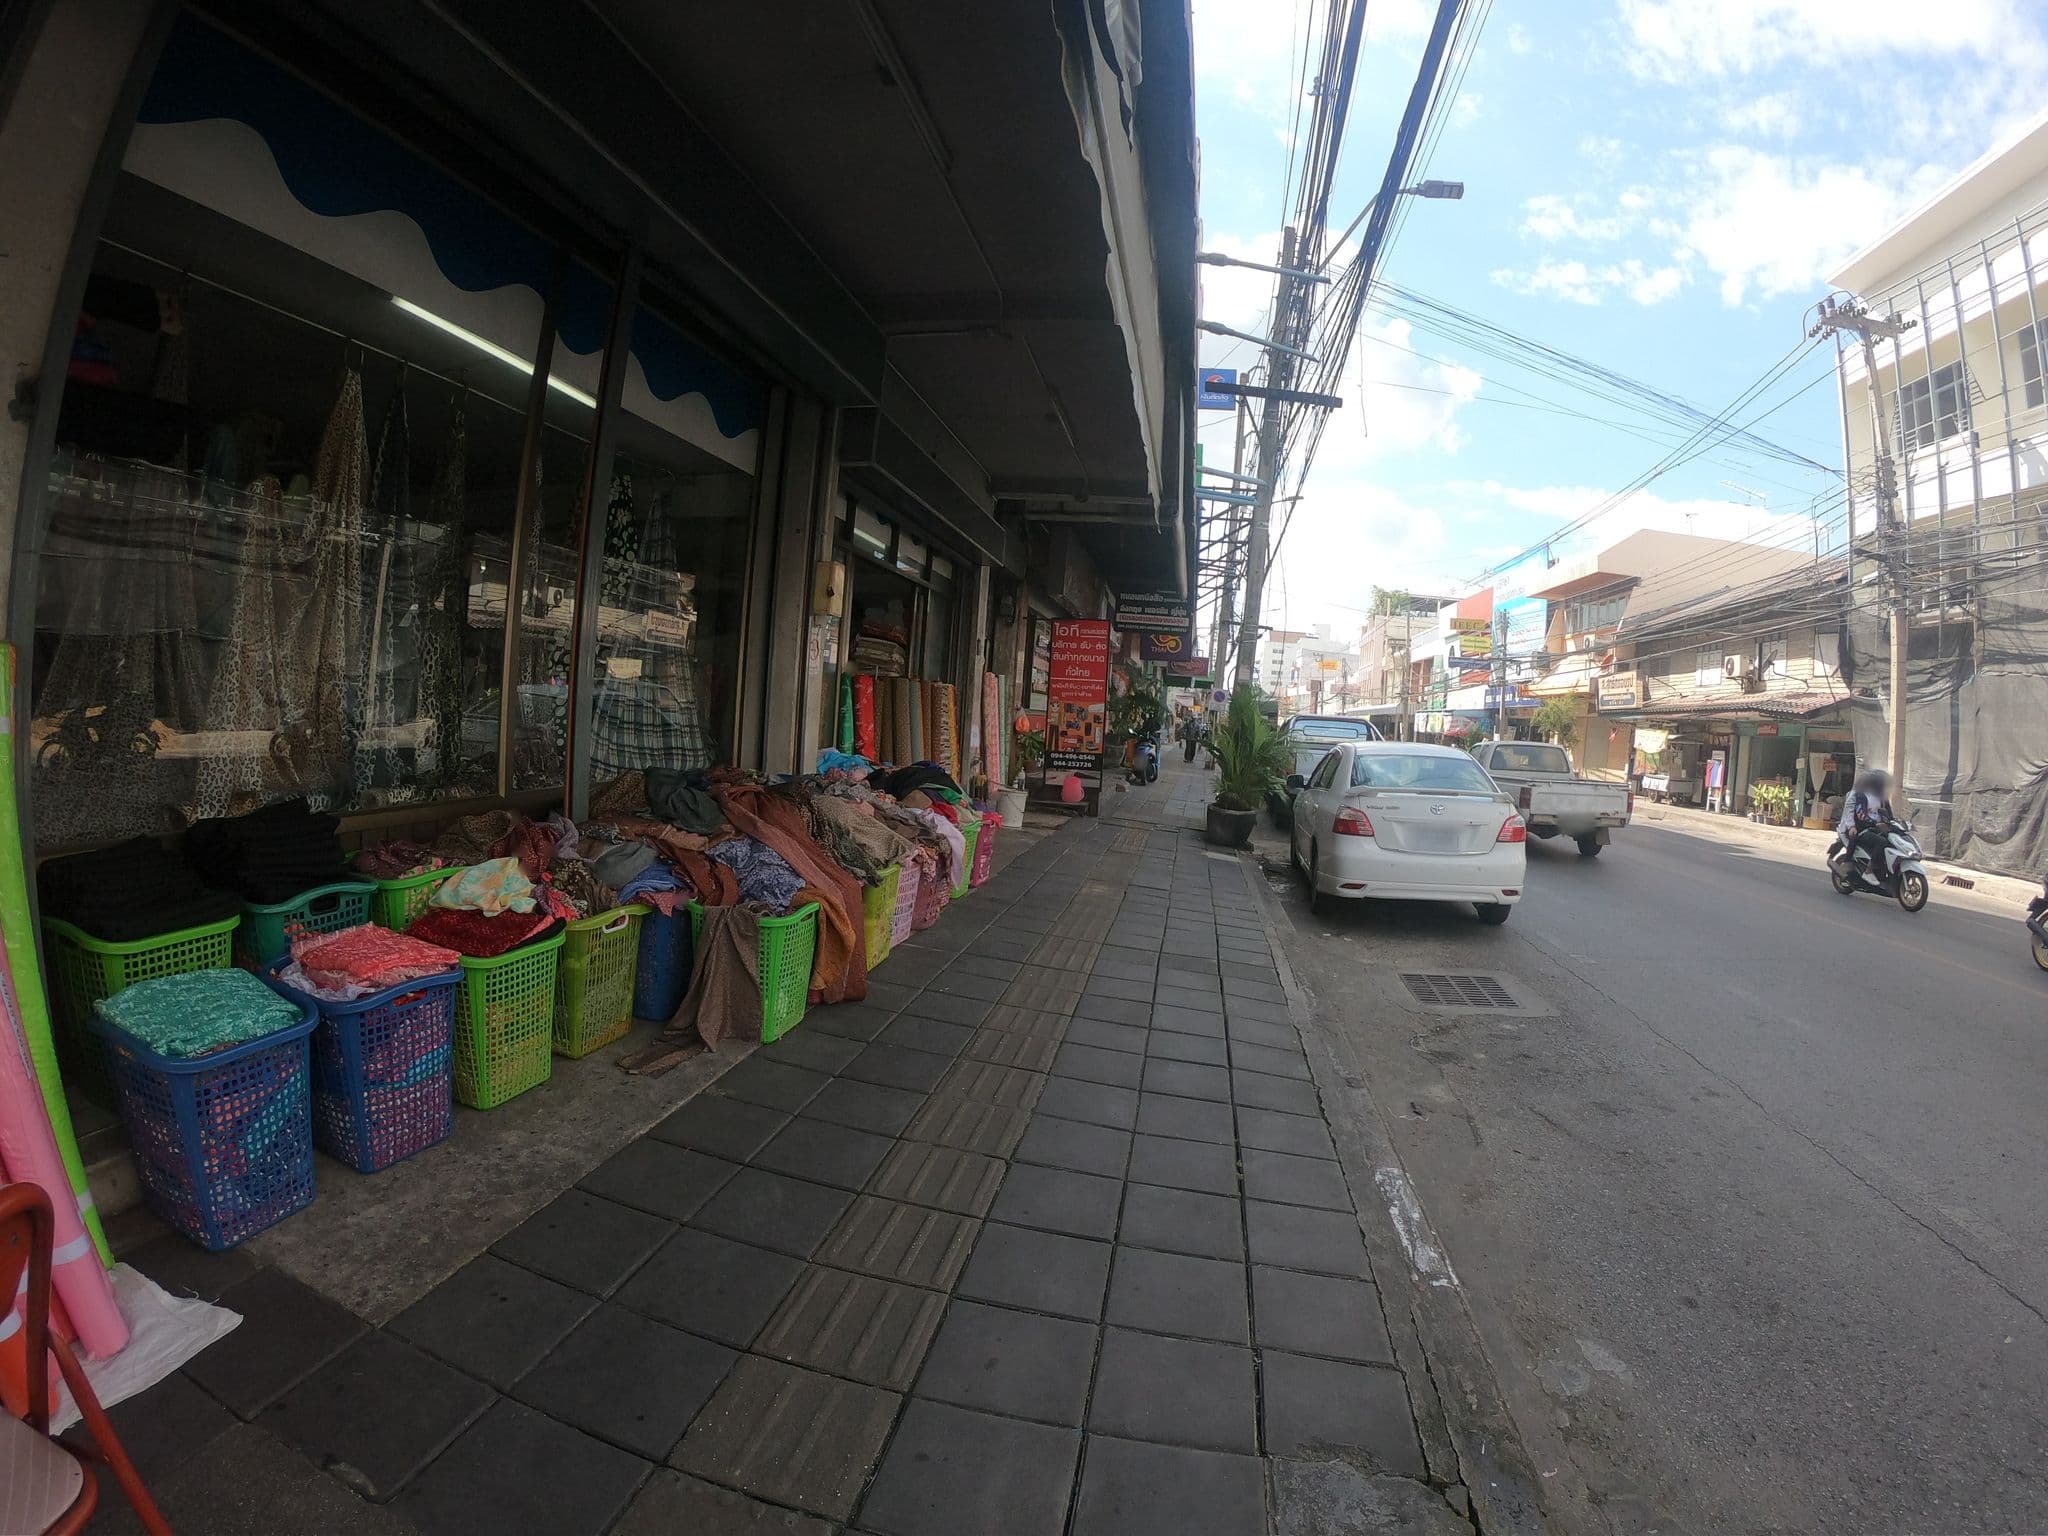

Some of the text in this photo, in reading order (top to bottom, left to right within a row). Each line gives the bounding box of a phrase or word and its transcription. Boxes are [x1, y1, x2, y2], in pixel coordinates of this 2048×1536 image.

[1054, 622, 1080, 637] ไอที
[1052, 651, 1105, 664] สินค้าทุกขนาด
[1065, 665, 1090, 677] ทั่วไทย
